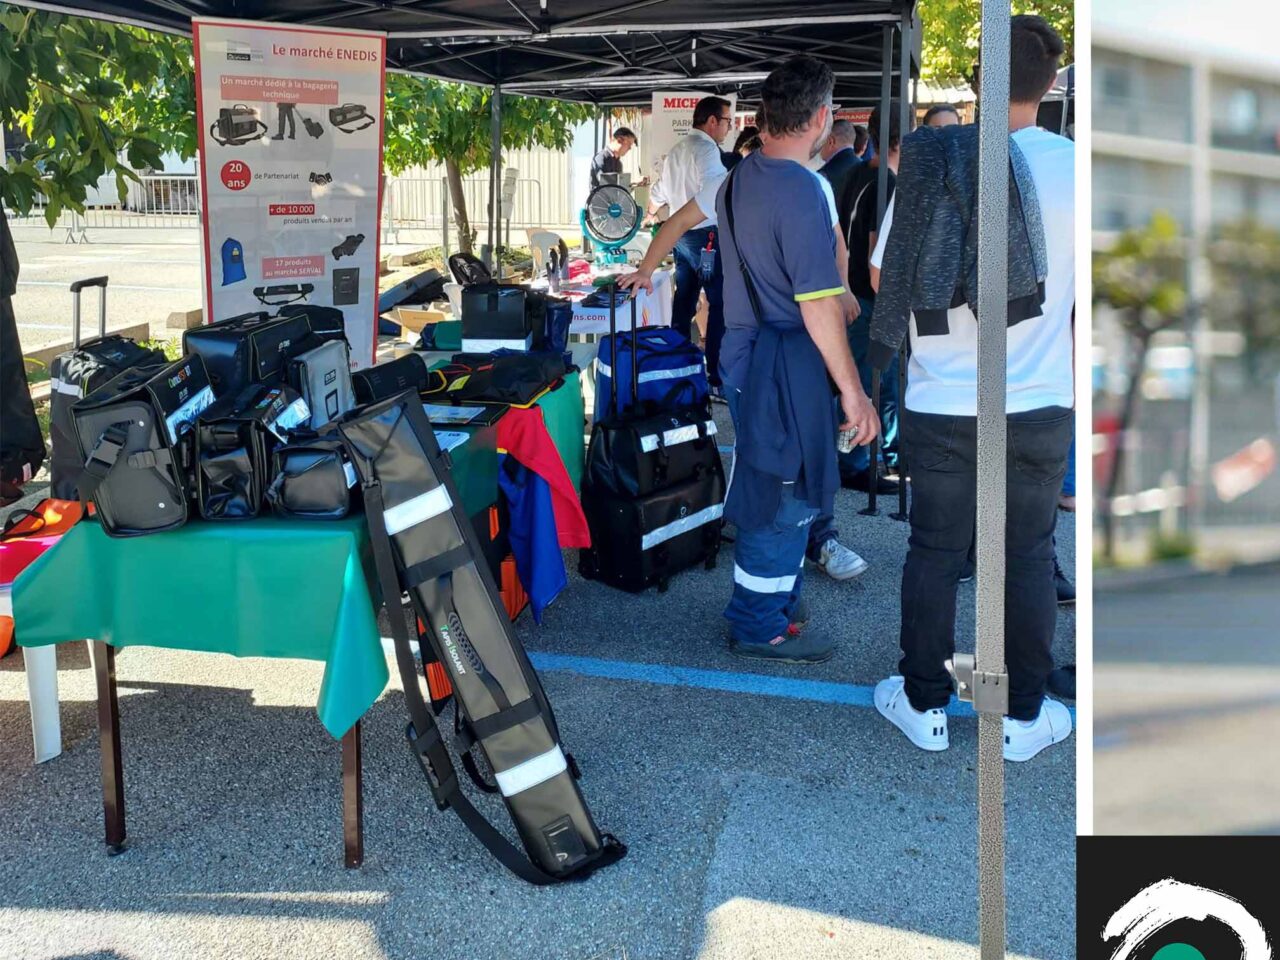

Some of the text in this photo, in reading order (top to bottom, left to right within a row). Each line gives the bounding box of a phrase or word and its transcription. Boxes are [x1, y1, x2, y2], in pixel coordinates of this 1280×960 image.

[272, 43, 378, 62] Le marché ENEDIS
[221, 76, 233, 85] Un
[235, 77, 263, 87] marché
[302, 81, 338, 92] bagagerie
[262, 90, 300, 100] technique
[663, 97, 699, 109] MICH
[229, 163, 243, 173] 20
[227, 180, 246, 188] ans
[276, 206, 286, 214] de
[288, 205, 298, 214] 10
[299, 205, 314, 214] 000
[283, 218, 310, 226] produits
[284, 259, 312, 267] produits
[274, 268, 298, 276] marché
